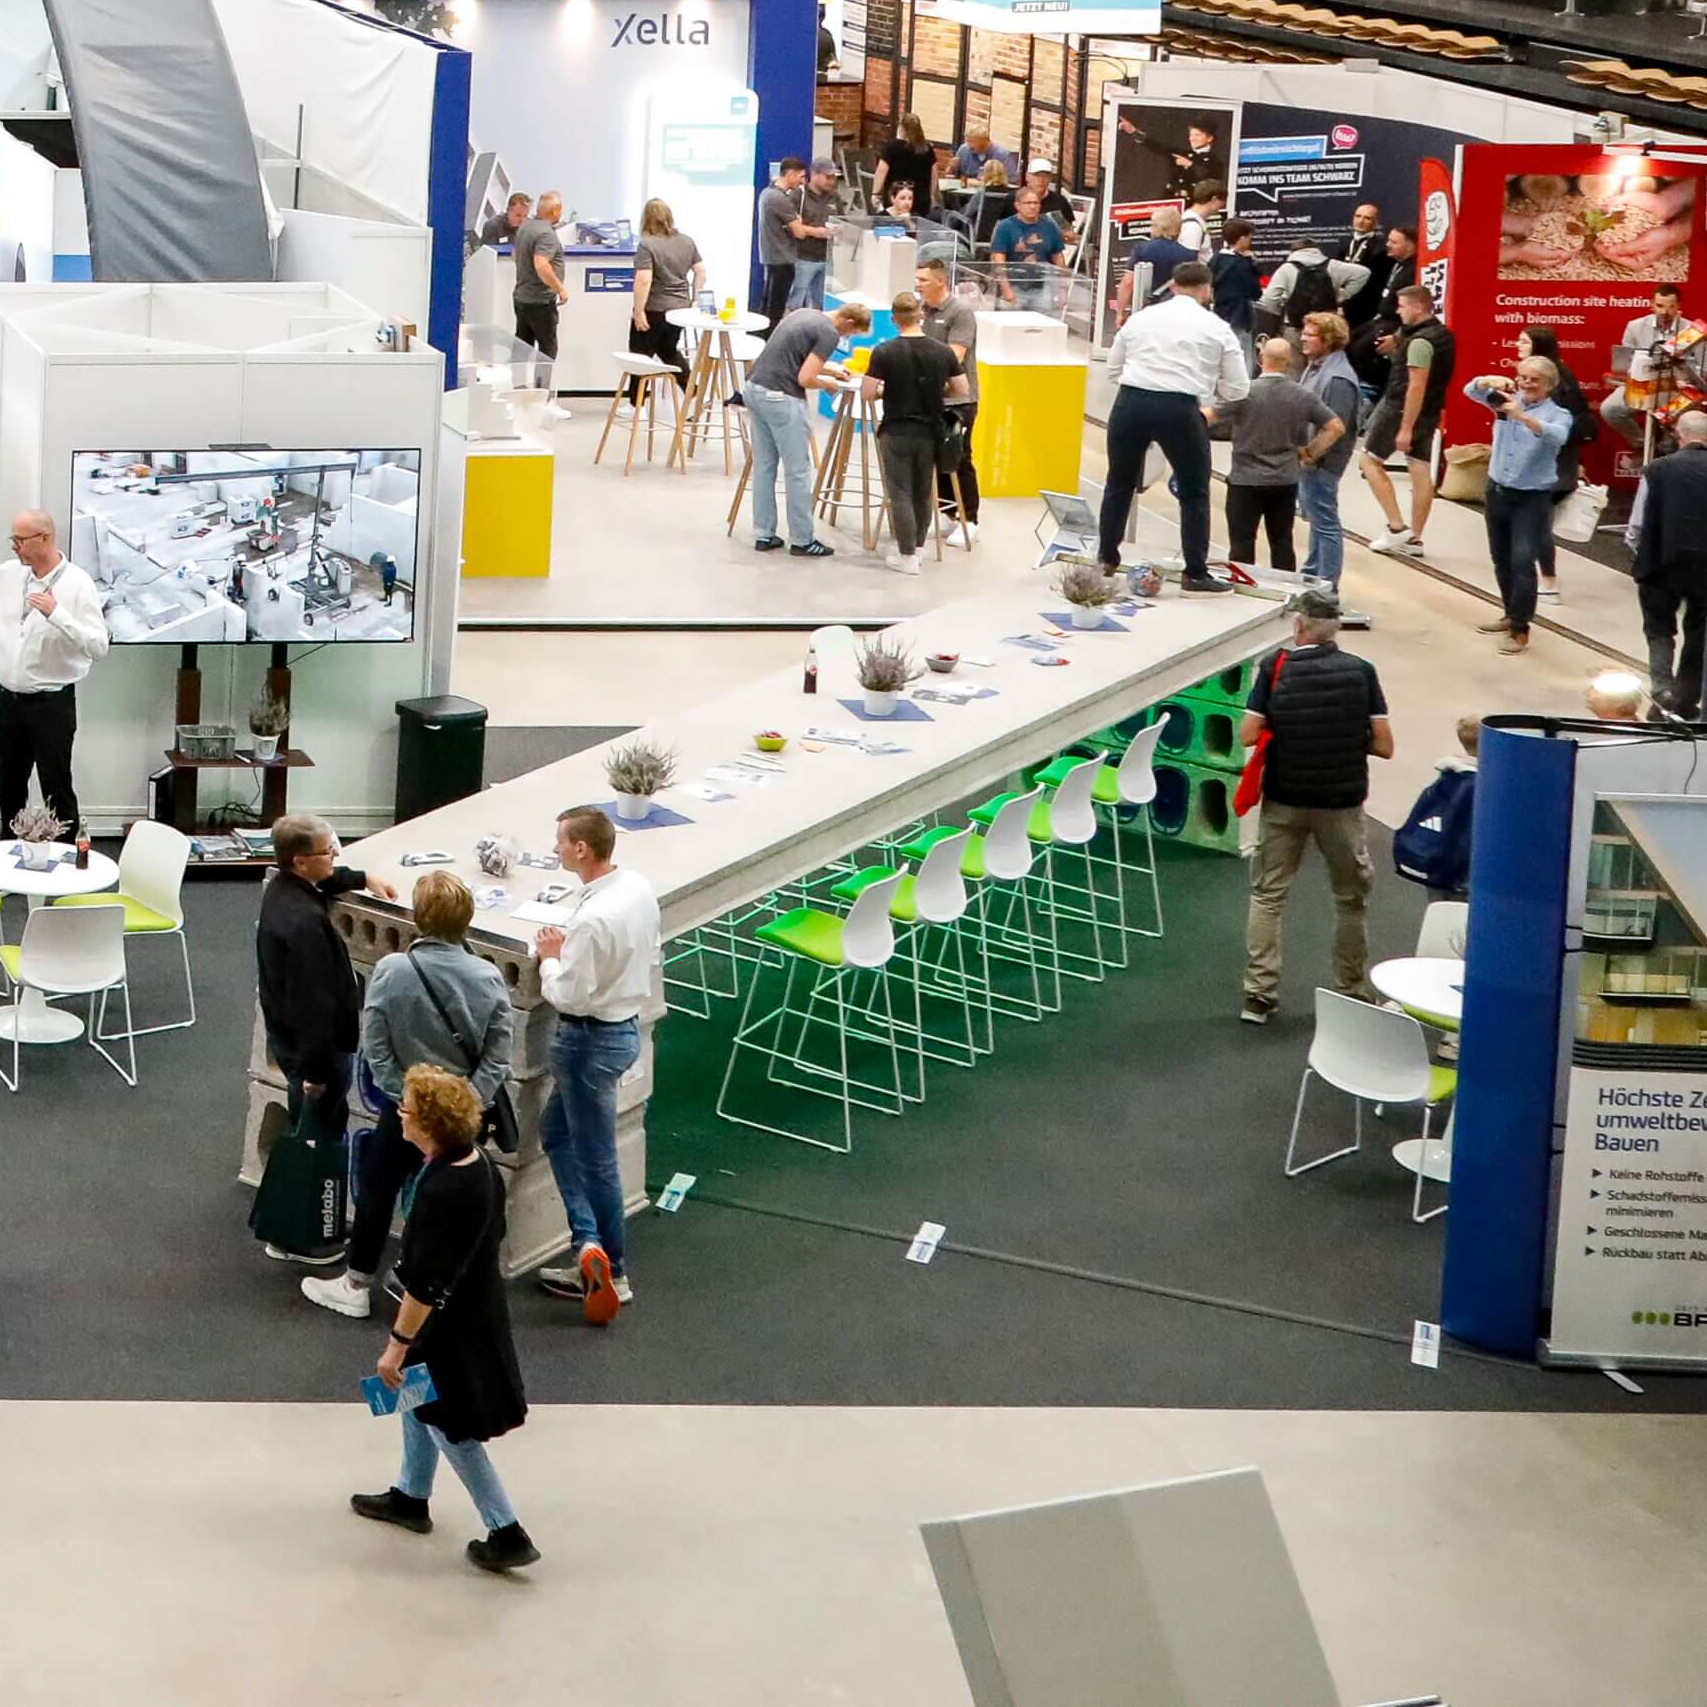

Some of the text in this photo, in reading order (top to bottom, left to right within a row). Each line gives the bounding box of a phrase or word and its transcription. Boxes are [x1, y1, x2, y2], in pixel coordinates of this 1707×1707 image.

[1013, 2, 1043, 12] JETZT
[610, 12, 710, 48] Xella
[1269, 174, 1285, 184] INS
[1286, 173, 1311, 183] TEAM
[1312, 171, 1355, 183] SCHWARZ
[1495, 294, 1652, 308] Construction site heatin
[1494, 312, 1585, 325] with biomass:
[1598, 1086, 1684, 1109] Höchste
[1594, 1134, 1659, 1153] Bauen
[1609, 1168, 1704, 1184] Keine Rohstoffe
[321, 1179, 335, 1238] metabo
[1605, 1206, 1674, 1219] minimieren
[1604, 1226, 1685, 1240] Geschlossene
[1602, 1246, 1654, 1260] Rückbau
[1656, 1249, 1686, 1261] statt
